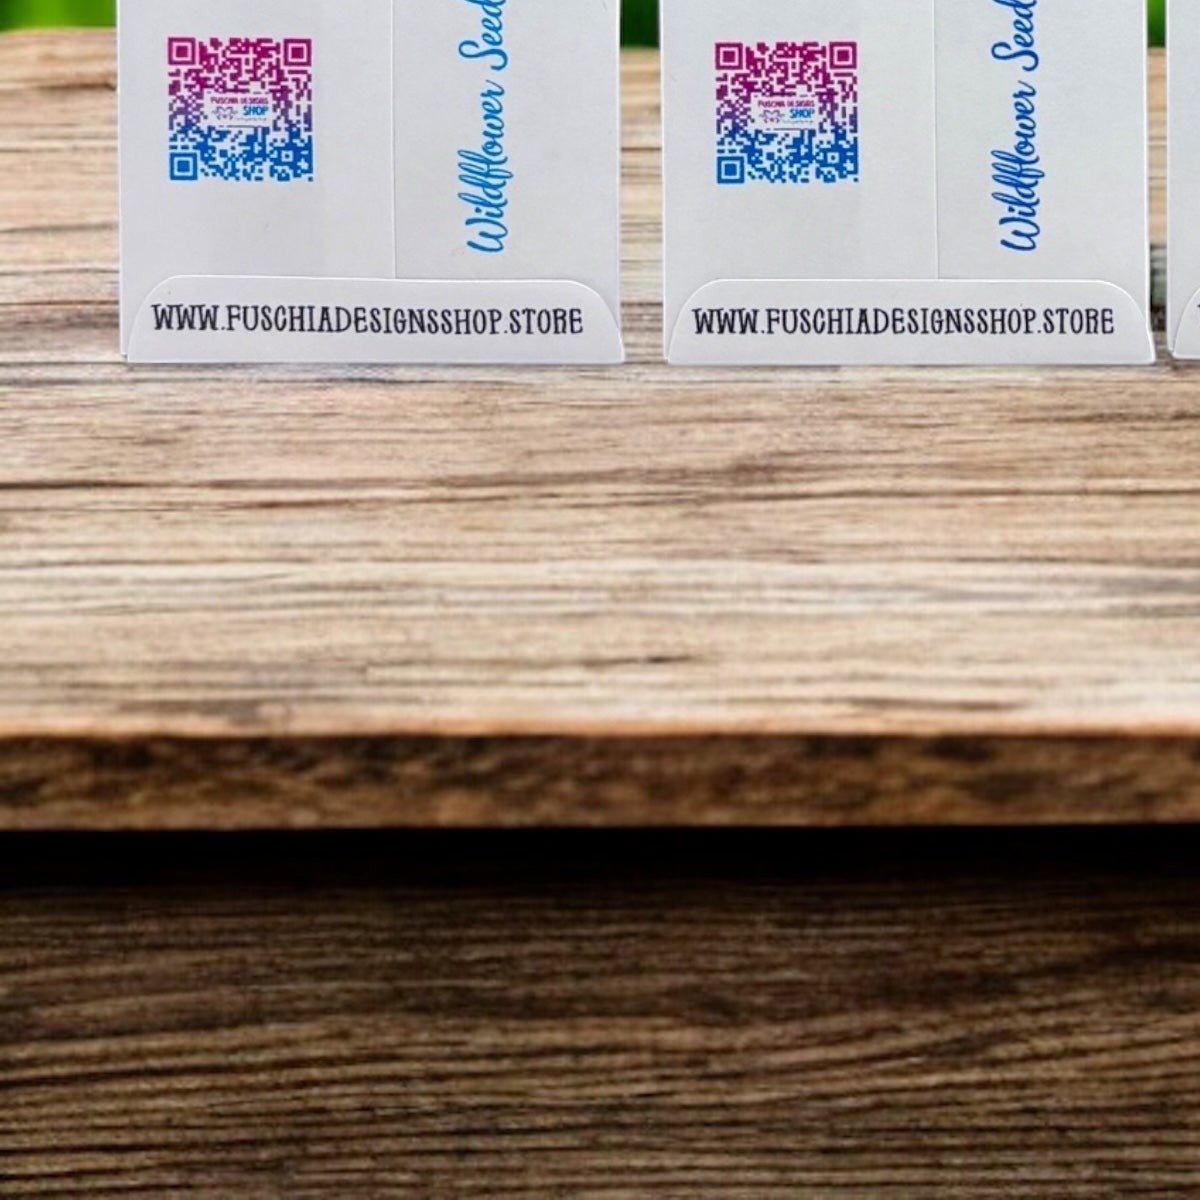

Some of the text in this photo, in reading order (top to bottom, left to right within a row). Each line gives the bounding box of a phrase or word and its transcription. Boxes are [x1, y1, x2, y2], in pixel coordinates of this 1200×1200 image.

[243, 105, 269, 116] SHOP
[790, 108, 815, 119] SHOP
[457, 80, 514, 255] Wildflower
[990, 80, 1046, 252] Wildflower
[151, 303, 584, 335] WWW.FUSCHIADESIGNSSHOP.STORE
[691, 307, 1114, 335] WWW.FUSCHIADESIGNSSHOP.STORE
